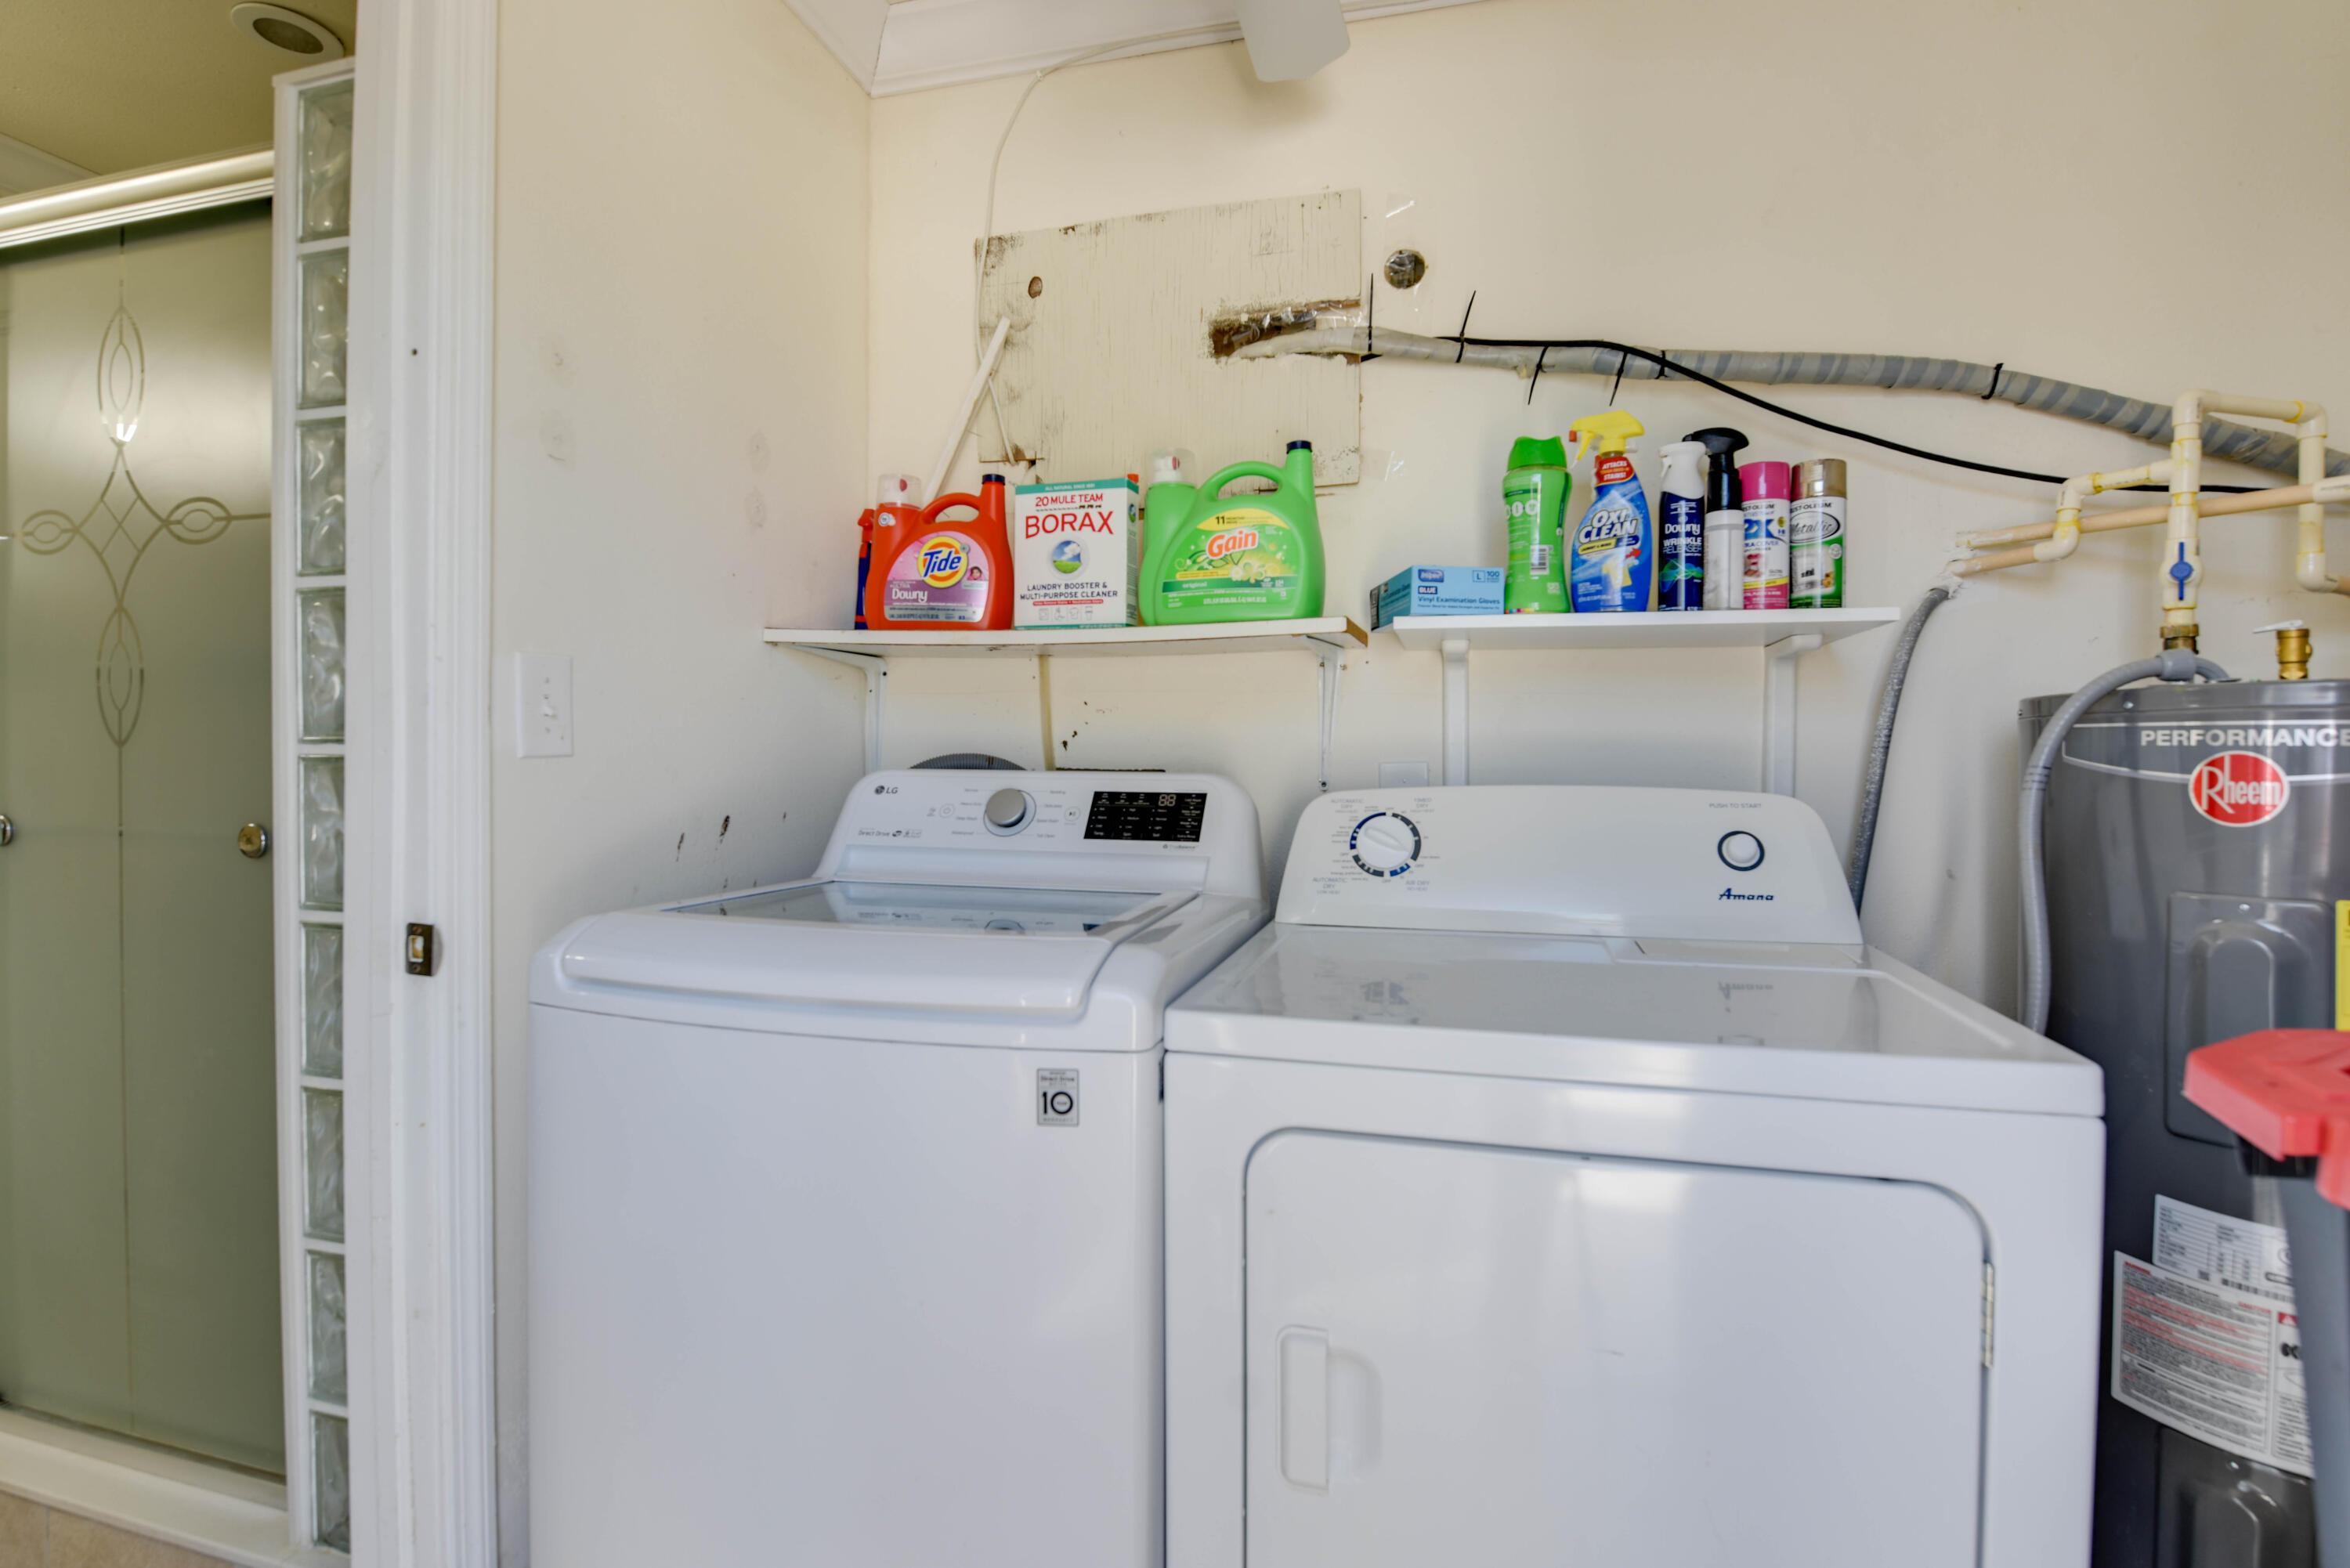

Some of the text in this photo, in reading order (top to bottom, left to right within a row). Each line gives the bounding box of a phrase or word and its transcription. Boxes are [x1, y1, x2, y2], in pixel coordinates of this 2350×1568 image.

[1035, 493, 1104, 508] 20 MULE TEAM
[1025, 511, 1114, 540] BORAX
[1215, 515, 1226, 525] 11
[1578, 518, 1638, 544] CLEAN
[1665, 523, 1701, 535] Downy
[1207, 530, 1257, 558] Gain
[1663, 537, 1702, 547] WRINKLE
[924, 550, 962, 578] Tide
[891, 588, 928, 602] Downy
[2202, 754, 2281, 814] Rheem
[1159, 794, 1177, 807] 88
[1719, 887, 1774, 901] Amana
[1043, 1091, 1074, 1115] 10
